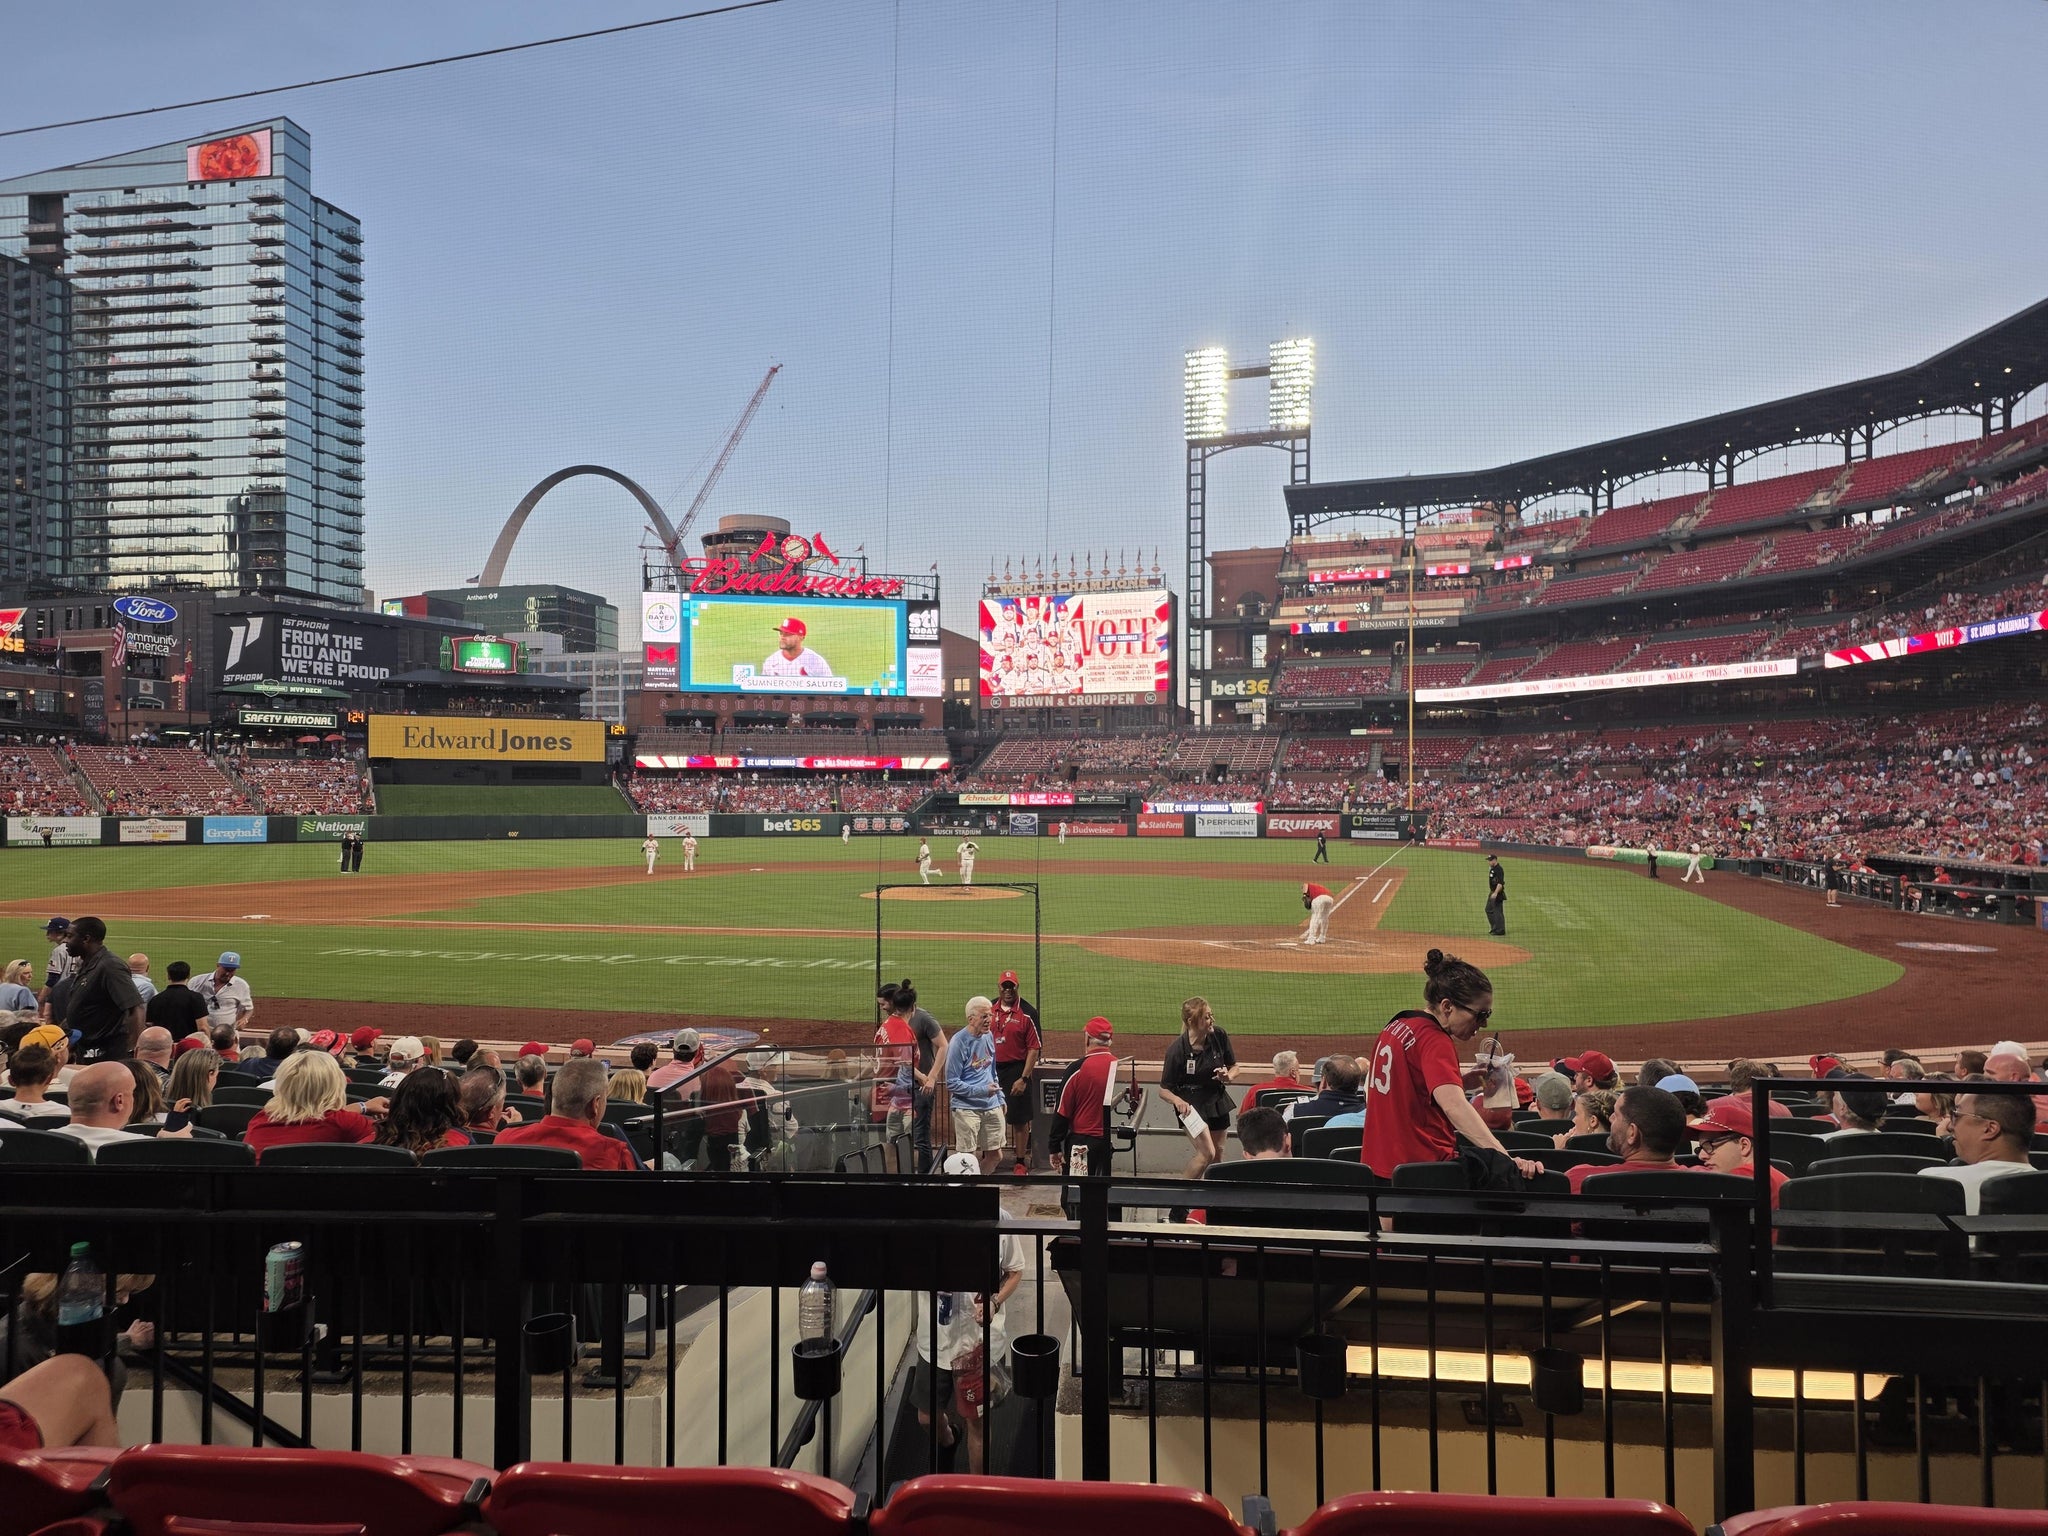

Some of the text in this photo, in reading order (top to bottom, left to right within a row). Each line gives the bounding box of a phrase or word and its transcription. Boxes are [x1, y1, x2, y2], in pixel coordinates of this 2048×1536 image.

[681, 557, 906, 595] Budweiser
[999, 578, 1149, 594] WORLD CHAMPIONS
[128, 598, 165, 619] Ford
[297, 620, 330, 630] PHORM
[909, 610, 938, 628] stl
[1359, 619, 1397, 629] BENJAMIN
[1309, 623, 1328, 633] VOTE
[1935, 632, 1954, 646] VOTE
[1979, 625, 1996, 637] LOUIS
[1997, 617, 2029, 634] CARDINALS
[126, 632, 178, 648] ommunity
[281, 628, 363, 650] FROM THE
[1071, 617, 1157, 656] VOTE
[281, 643, 351, 663] LOU AND
[281, 658, 390, 680] WE'RE PROUD
[1667, 672, 1693, 681] WALKER
[1743, 664, 1779, 674] HERRERA
[235, 673, 263, 682] PHORM
[281, 675, 344, 687] #IAM1STPHORM
[807, 680, 843, 688] SALUTES
[1211, 679, 1270, 696] bet36
[753, 699, 765, 711] 14
[772, 700, 784, 711] 17
[834, 701, 848, 712] 24
[855, 701, 868, 712] 42
[1009, 696, 1054, 708] BROWN
[1058, 698, 1065, 706] &
[1068, 694, 1135, 705] CROUPPEN
[244, 714, 333, 725] SAFETY NATIONAL
[348, 712, 364, 723] 1:24
[611, 725, 625, 735] 1:24
[714, 757, 732, 767] VOTE
[1155, 803, 1174, 813] VOTE
[1183, 803, 1199, 812] LOUIS
[1200, 803, 1228, 812] CARDINALS
[1229, 802, 1249, 813] VOTE
[316, 821, 363, 831] National
[763, 819, 821, 832] bet365
[1015, 815, 1032, 824] Ford
[1269, 819, 1334, 831] EQUIFAX
[1073, 826, 1115, 834] Budweiser
[1369, 1041, 1393, 1095] 13
